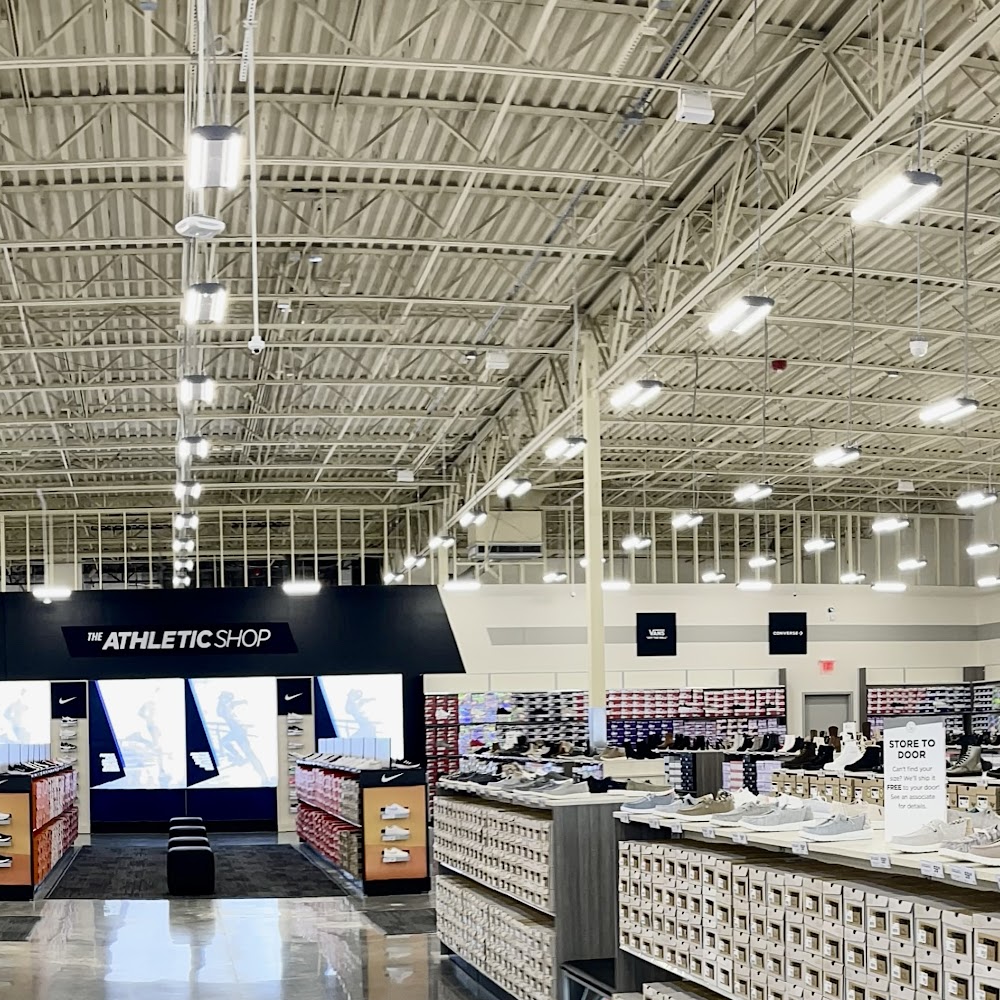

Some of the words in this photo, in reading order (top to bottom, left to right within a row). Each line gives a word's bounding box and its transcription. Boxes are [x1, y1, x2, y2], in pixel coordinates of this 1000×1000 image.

[87, 632, 103, 642] THE
[102, 630, 213, 650] ATHLETIC
[214, 629, 271, 648] SHOP
[889, 740, 919, 748] STORE
[922, 739, 936, 747] TO
[898, 751, 926, 759] DOOR
